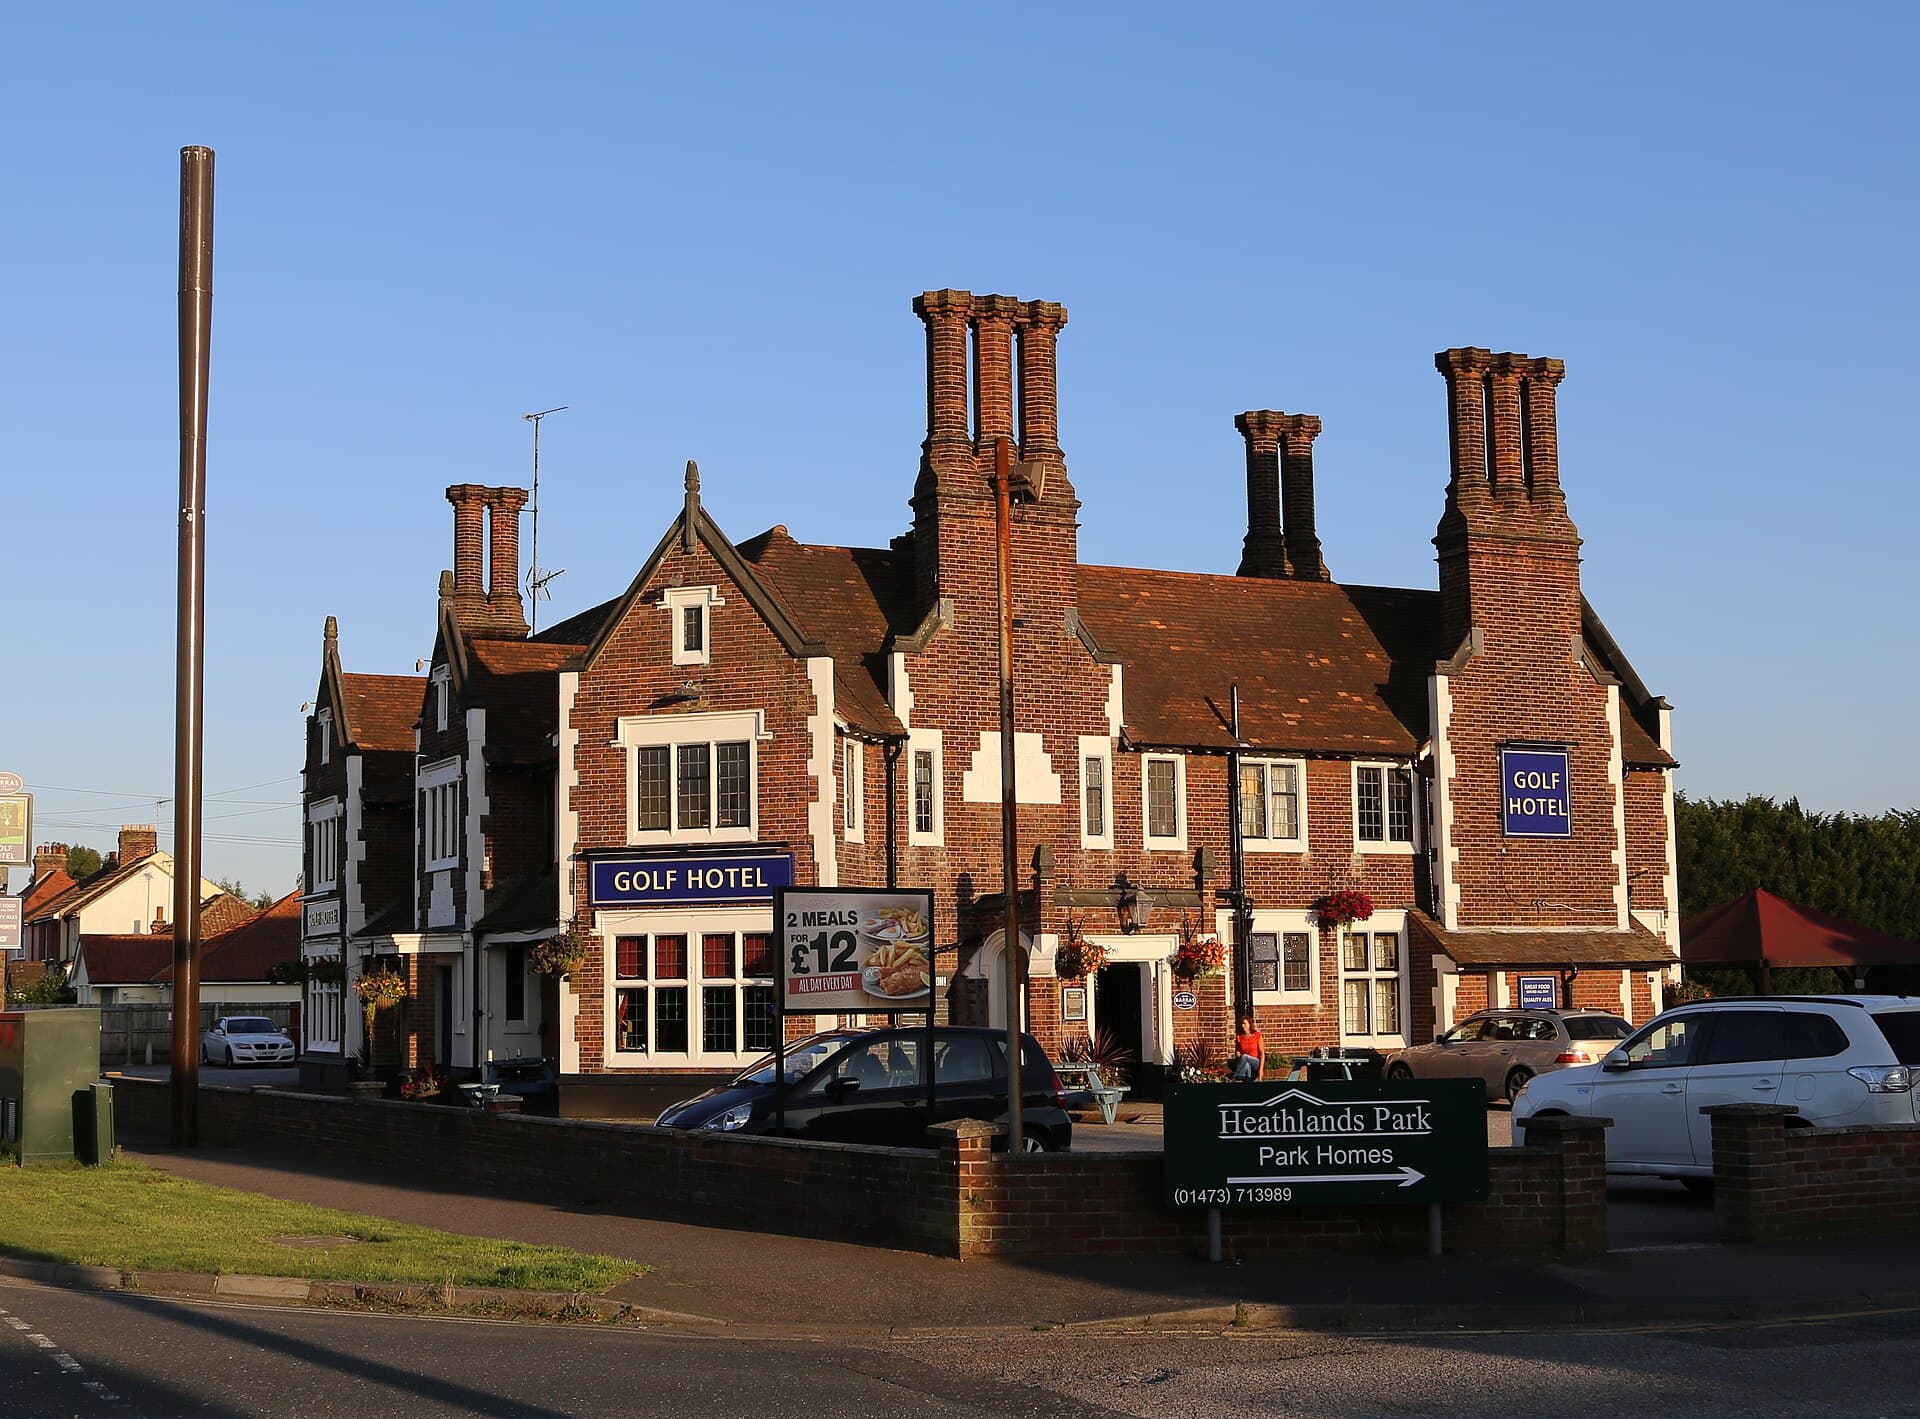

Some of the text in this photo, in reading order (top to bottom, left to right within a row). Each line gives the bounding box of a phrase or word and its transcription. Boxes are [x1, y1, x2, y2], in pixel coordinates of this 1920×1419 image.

[1513, 771, 1560, 790] GOLF
[1509, 797, 1568, 817] HOTEL
[614, 867, 769, 892] GOLF HOTEL
[787, 910, 858, 928] 2 MEALS
[790, 934, 809, 943] FOR
[798, 975, 853, 993] ALL DAY EVERY DAY
[1218, 1105, 1433, 1134] Heathlands Park
[1259, 1145, 1394, 1166] Park Homes
[1174, 1187, 1292, 1205] (01473) 713989
